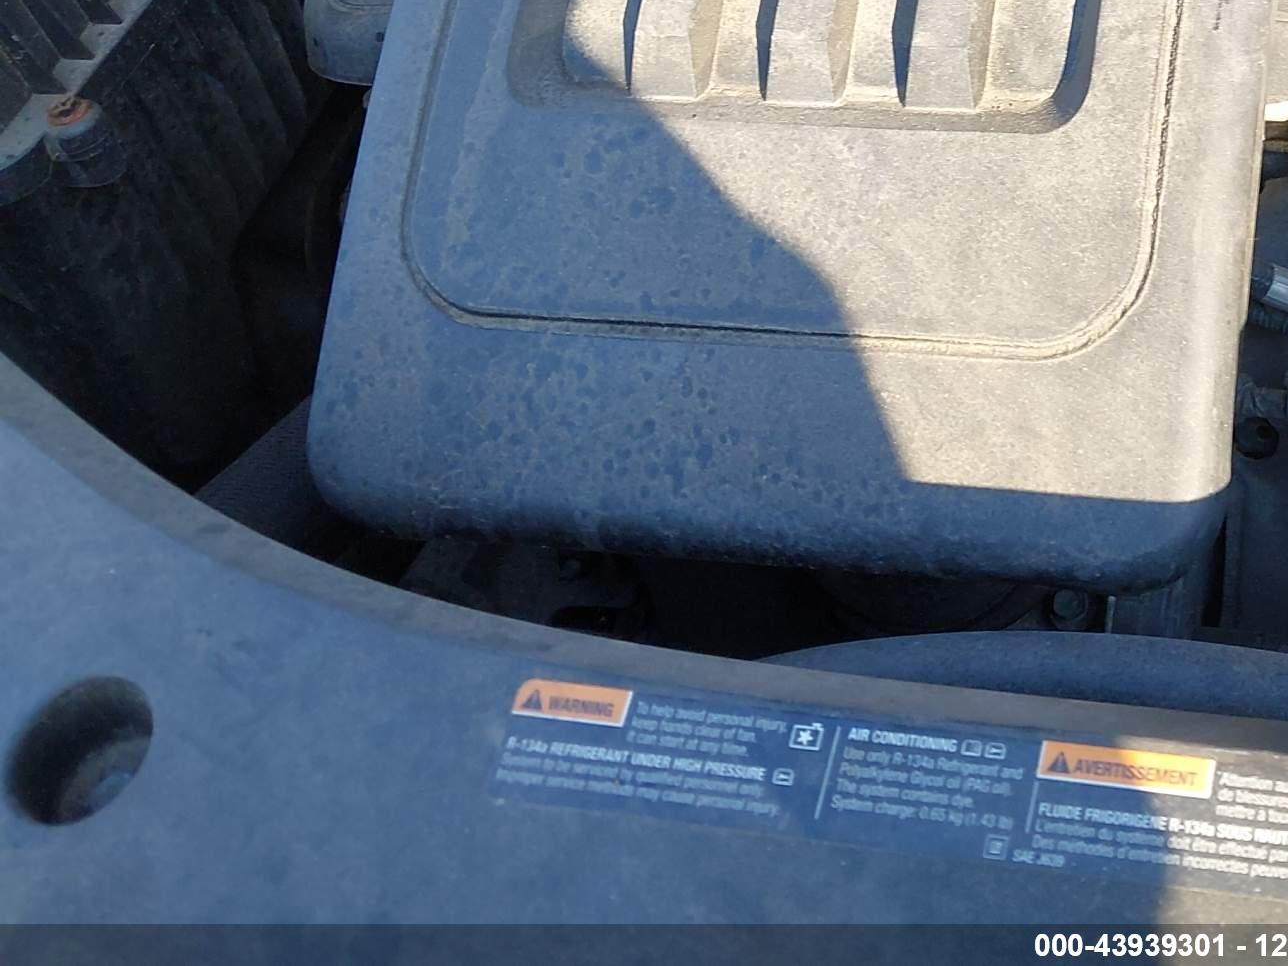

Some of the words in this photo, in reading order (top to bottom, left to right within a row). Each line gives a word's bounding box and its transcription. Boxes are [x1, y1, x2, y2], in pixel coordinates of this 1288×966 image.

[548, 696, 614, 717] WARNING
[651, 704, 674, 718] help
[675, 708, 706, 721] avoid
[706, 712, 754, 727] personal
[660, 719, 693, 735] hands
[694, 725, 721, 738] clear
[723, 727, 737, 739] of
[848, 727, 870, 742] AIR
[871, 730, 958, 753] CONDITIONING
[636, 734, 657, 745] can
[658, 735, 685, 748] start
[685, 738, 698, 750] at
[699, 741, 721, 755] any
[506, 736, 548, 753] R-134a
[549, 741, 629, 763] REFRIGERANT
[631, 751, 671, 768] UNDER
[672, 757, 703, 773] HIGH
[703, 761, 767, 781] PRESSURE
[843, 746, 865, 761] Use
[866, 750, 890, 766] only
[892, 752, 935, 769] R-134a
[1000, 766, 1024, 781] and
[1074, 758, 1198, 786] AVERTISSEMENT
[683, 777, 738, 793] personnel
[858, 783, 900, 799] system
[900, 788, 949, 806] contains
[1217, 787, 1234, 803] de
[635, 787, 659, 802] may
[661, 790, 695, 804] cause
[696, 793, 745, 810] personal
[830, 794, 874, 813] System
[947, 809, 963, 827] kg
[1038, 802, 1083, 821] FLUIDE
[1168, 817, 1216, 837] R-134a
[1216, 822, 1252, 842] SOUS
[1031, 833, 1055, 850] Des
[1098, 826, 1113, 841] du
[1012, 848, 1035, 865] SAE
